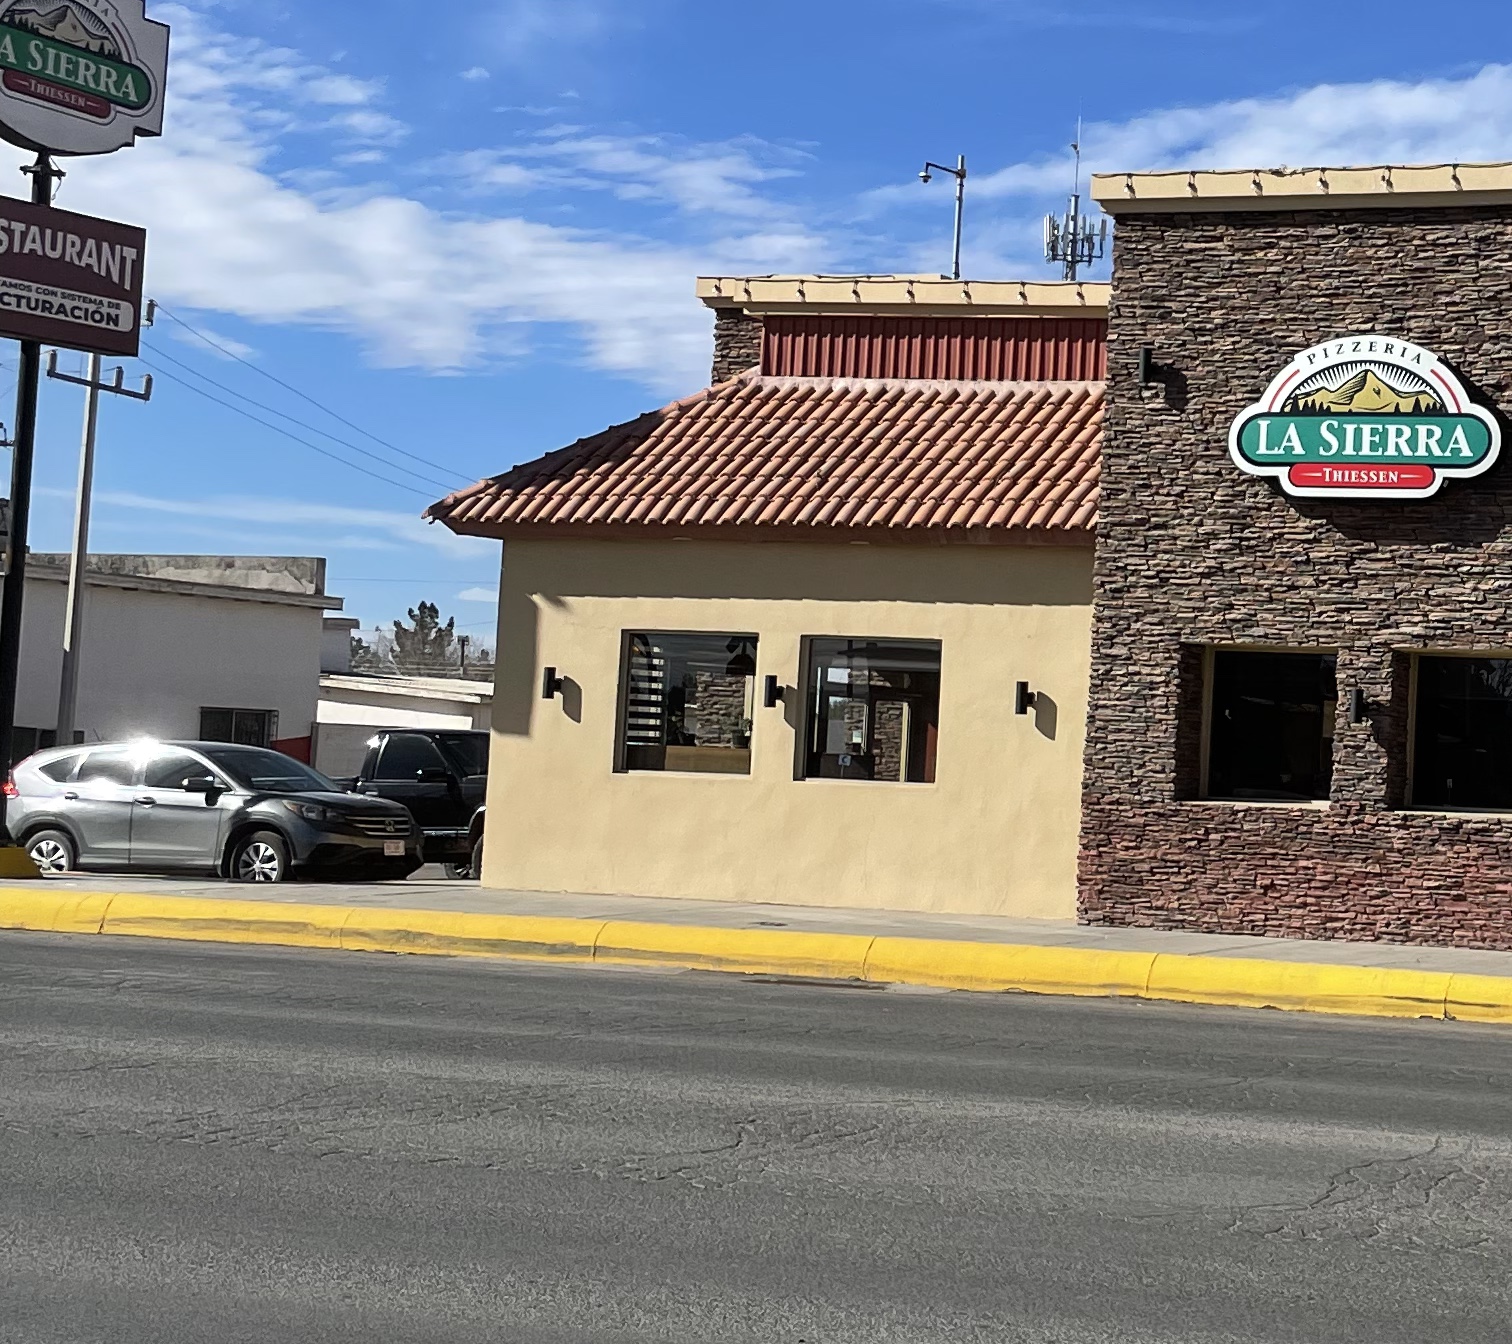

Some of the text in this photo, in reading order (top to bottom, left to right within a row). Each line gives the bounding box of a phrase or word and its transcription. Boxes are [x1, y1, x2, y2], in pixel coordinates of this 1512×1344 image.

[28, 40, 138, 102] SIERRA
[29, 79, 86, 106] THIESSEN
[0, 279, 121, 310] AMOS CON SISTEMA DE
[1306, 340, 1422, 366] PIZZERIA
[1256, 420, 1474, 457] LA SIERRA
[1323, 467, 1399, 484] THIESSEN
